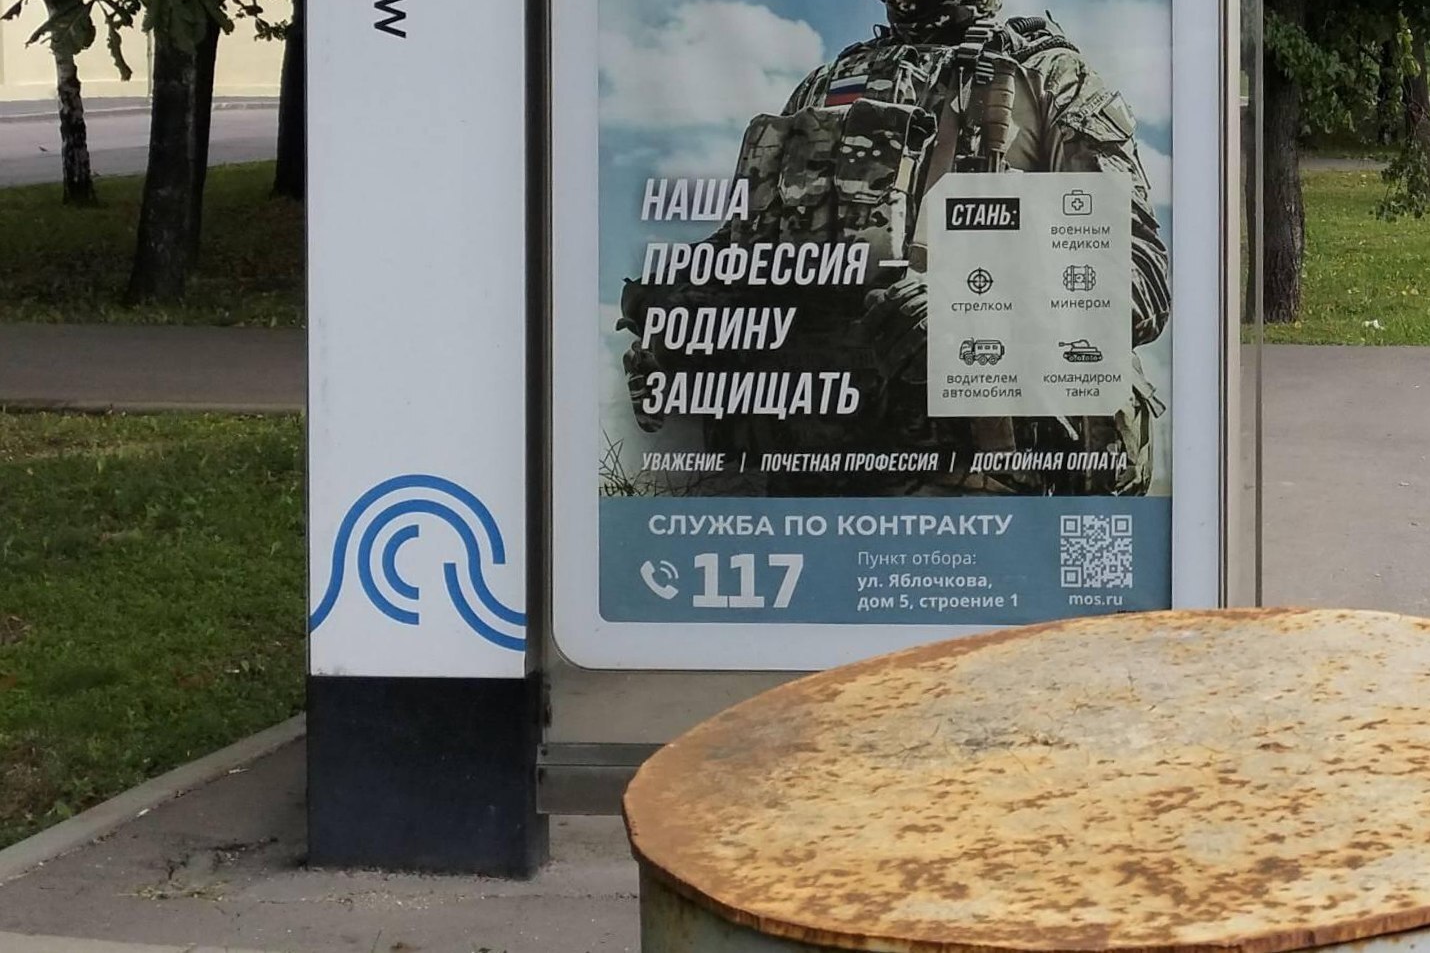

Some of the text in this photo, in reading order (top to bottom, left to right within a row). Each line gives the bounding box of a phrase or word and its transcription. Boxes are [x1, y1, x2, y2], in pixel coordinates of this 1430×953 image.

[641, 178, 750, 221] НАША
[951, 204, 1018, 226] СТАНЬ:
[1050, 225, 1111, 236] военным
[1052, 240, 1110, 251] медиком
[641, 242, 870, 286] ПРОФЕССИЯ
[951, 302, 1013, 314] стрелком
[1050, 300, 1111, 311] минером
[641, 306, 797, 355] РОДИНУ
[947, 374, 1018, 386] водителем
[1043, 373, 1121, 385] командиром
[642, 371, 860, 420] ЗАЩИЩАТЬ
[942, 386, 1022, 398] автомобиля
[1066, 387, 1100, 397] танка
[641, 449, 1128, 473] УВАЖЕНИЕ ПОЧЕТНАЯ ПРОФЕССИЯ ДОСТОЙНАЯ ОПЛАТА
[648, 514, 1013, 536] СЛУЖБА ПО КОНТРАКТУ
[858, 551, 977, 568] Пункт отбора:
[693, 553, 804, 608] 117
[857, 574, 992, 591] ул. Яблочкова,
[857, 594, 1018, 612] дом 5, строение 1
[1069, 595, 1123, 606] mos.ru
